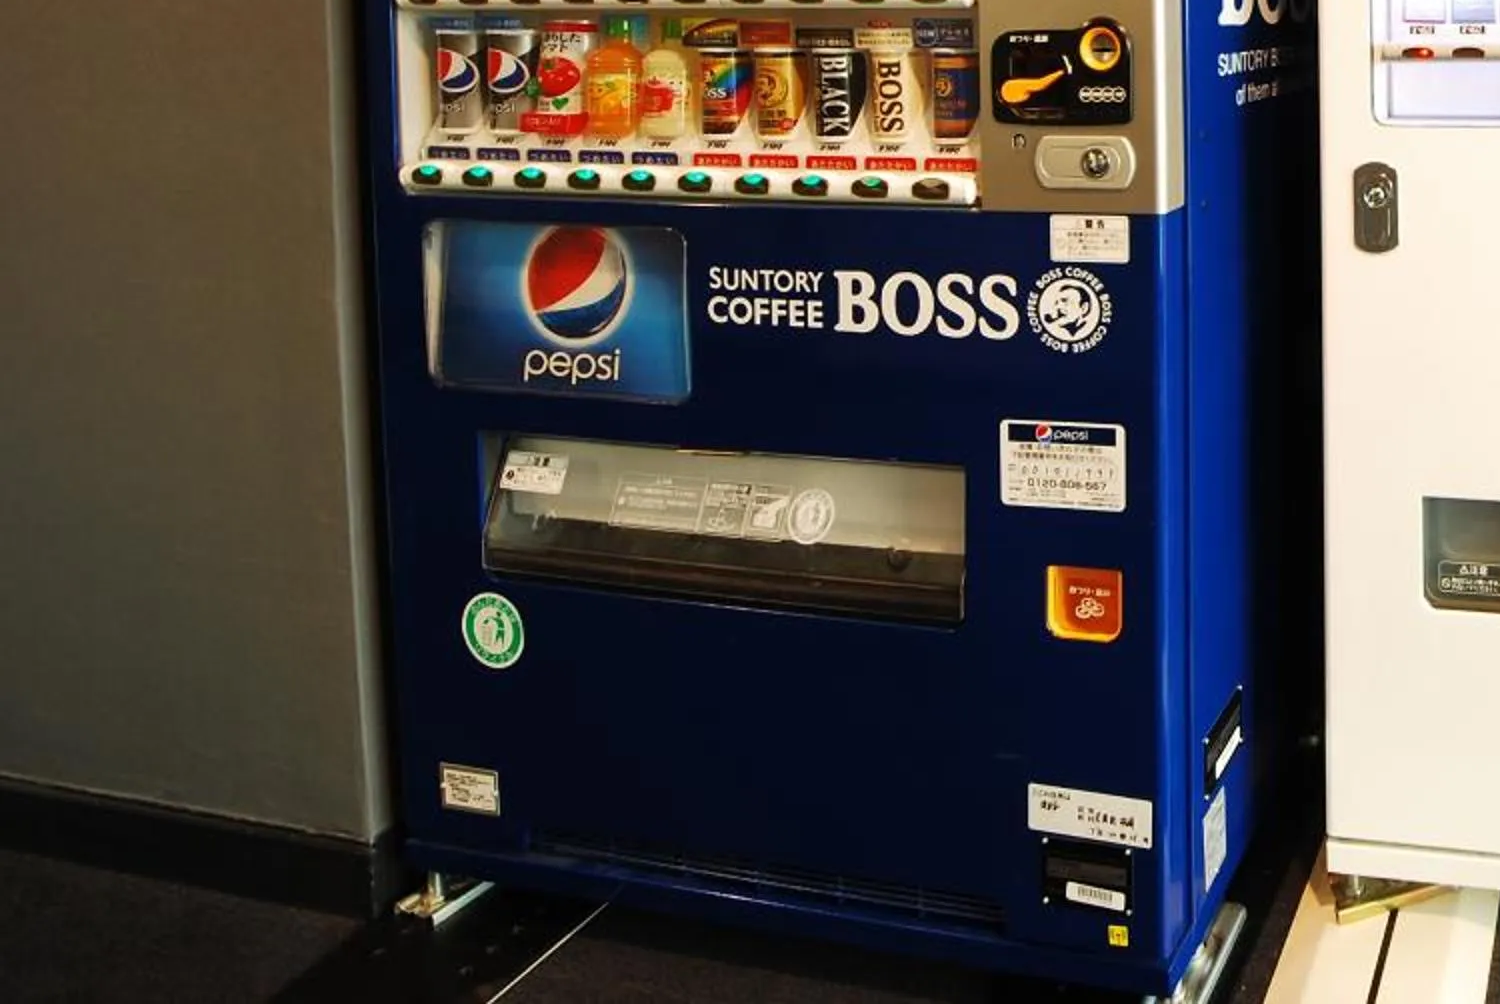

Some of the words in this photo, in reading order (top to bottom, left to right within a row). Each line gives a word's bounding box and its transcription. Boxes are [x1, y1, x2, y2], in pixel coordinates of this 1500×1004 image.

[820, 54, 851, 136] BLACK
[878, 60, 905, 133] BOSS
[708, 266, 824, 293] SUNTORY
[1035, 267, 1063, 289] BOSS
[1065, 266, 1105, 292] COFFEE
[707, 297, 824, 328] COFFEE
[834, 270, 1020, 339] BOSS
[1026, 291, 1042, 333] COFFEE
[1099, 293, 1113, 324] BOSS
[1040, 333, 1068, 353] BOSS
[1072, 325, 1107, 353] COFFEE
[523, 349, 621, 385] pepsi
[1053, 429, 1089, 441] pepsi
